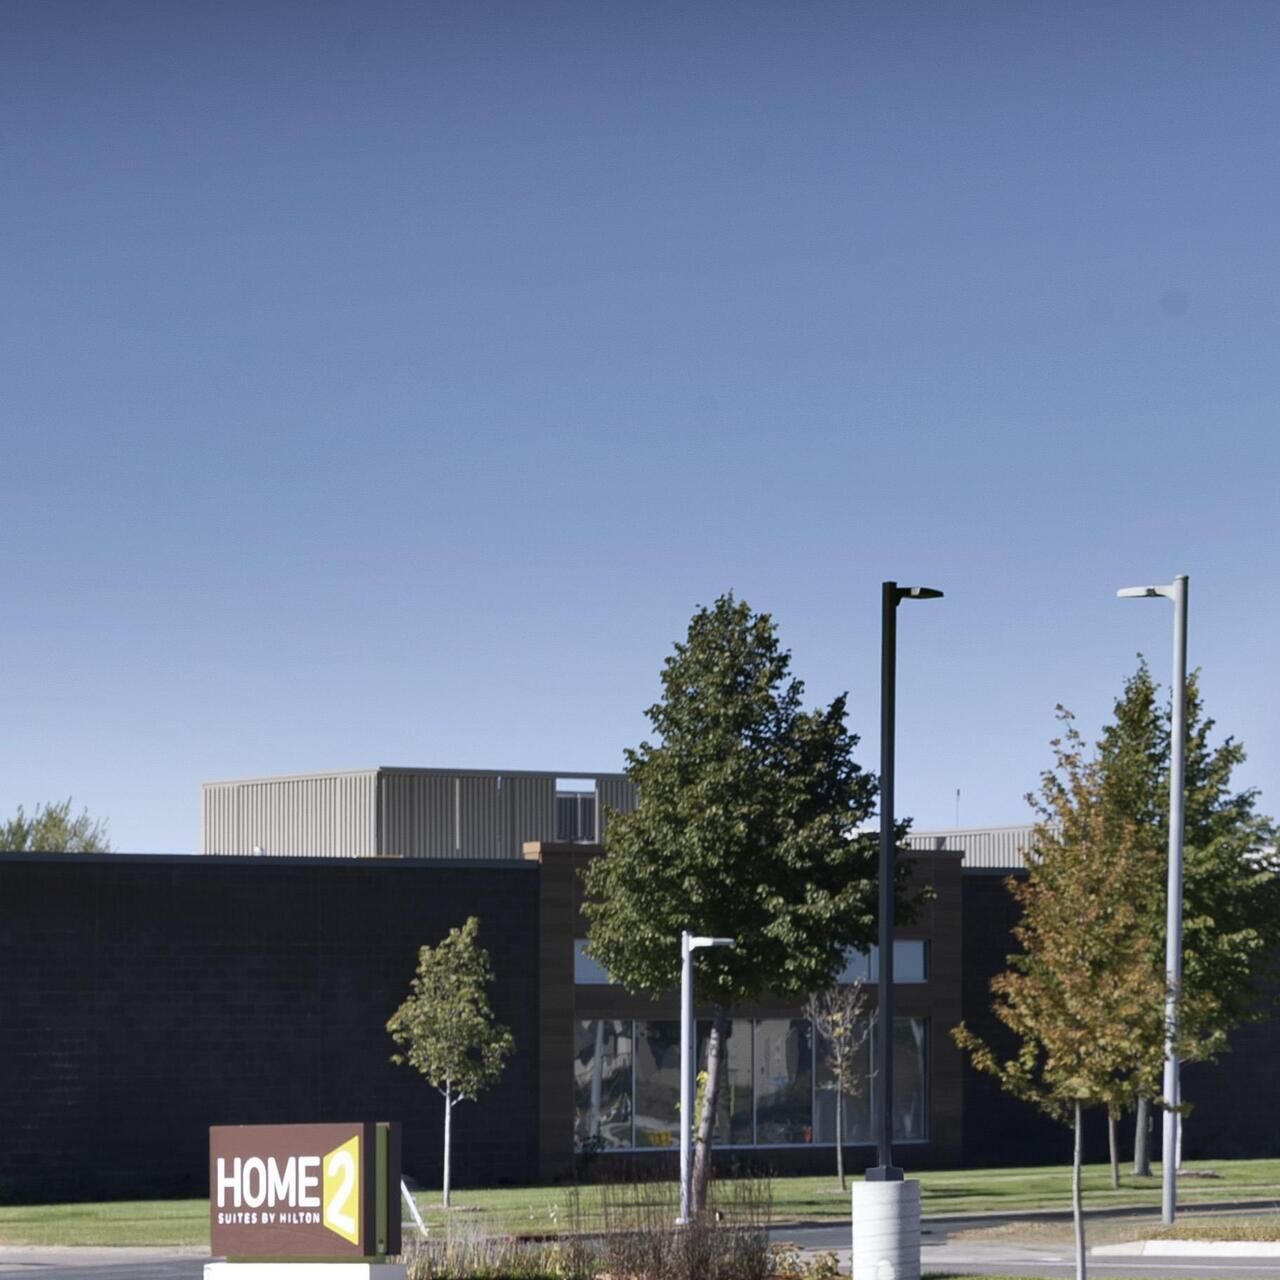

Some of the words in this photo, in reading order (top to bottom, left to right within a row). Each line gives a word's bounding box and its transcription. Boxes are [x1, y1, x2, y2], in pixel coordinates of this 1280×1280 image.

[217, 1212, 258, 1225] SUITES
[261, 1212, 276, 1224] BY
[279, 1211, 320, 1224] HILTON
